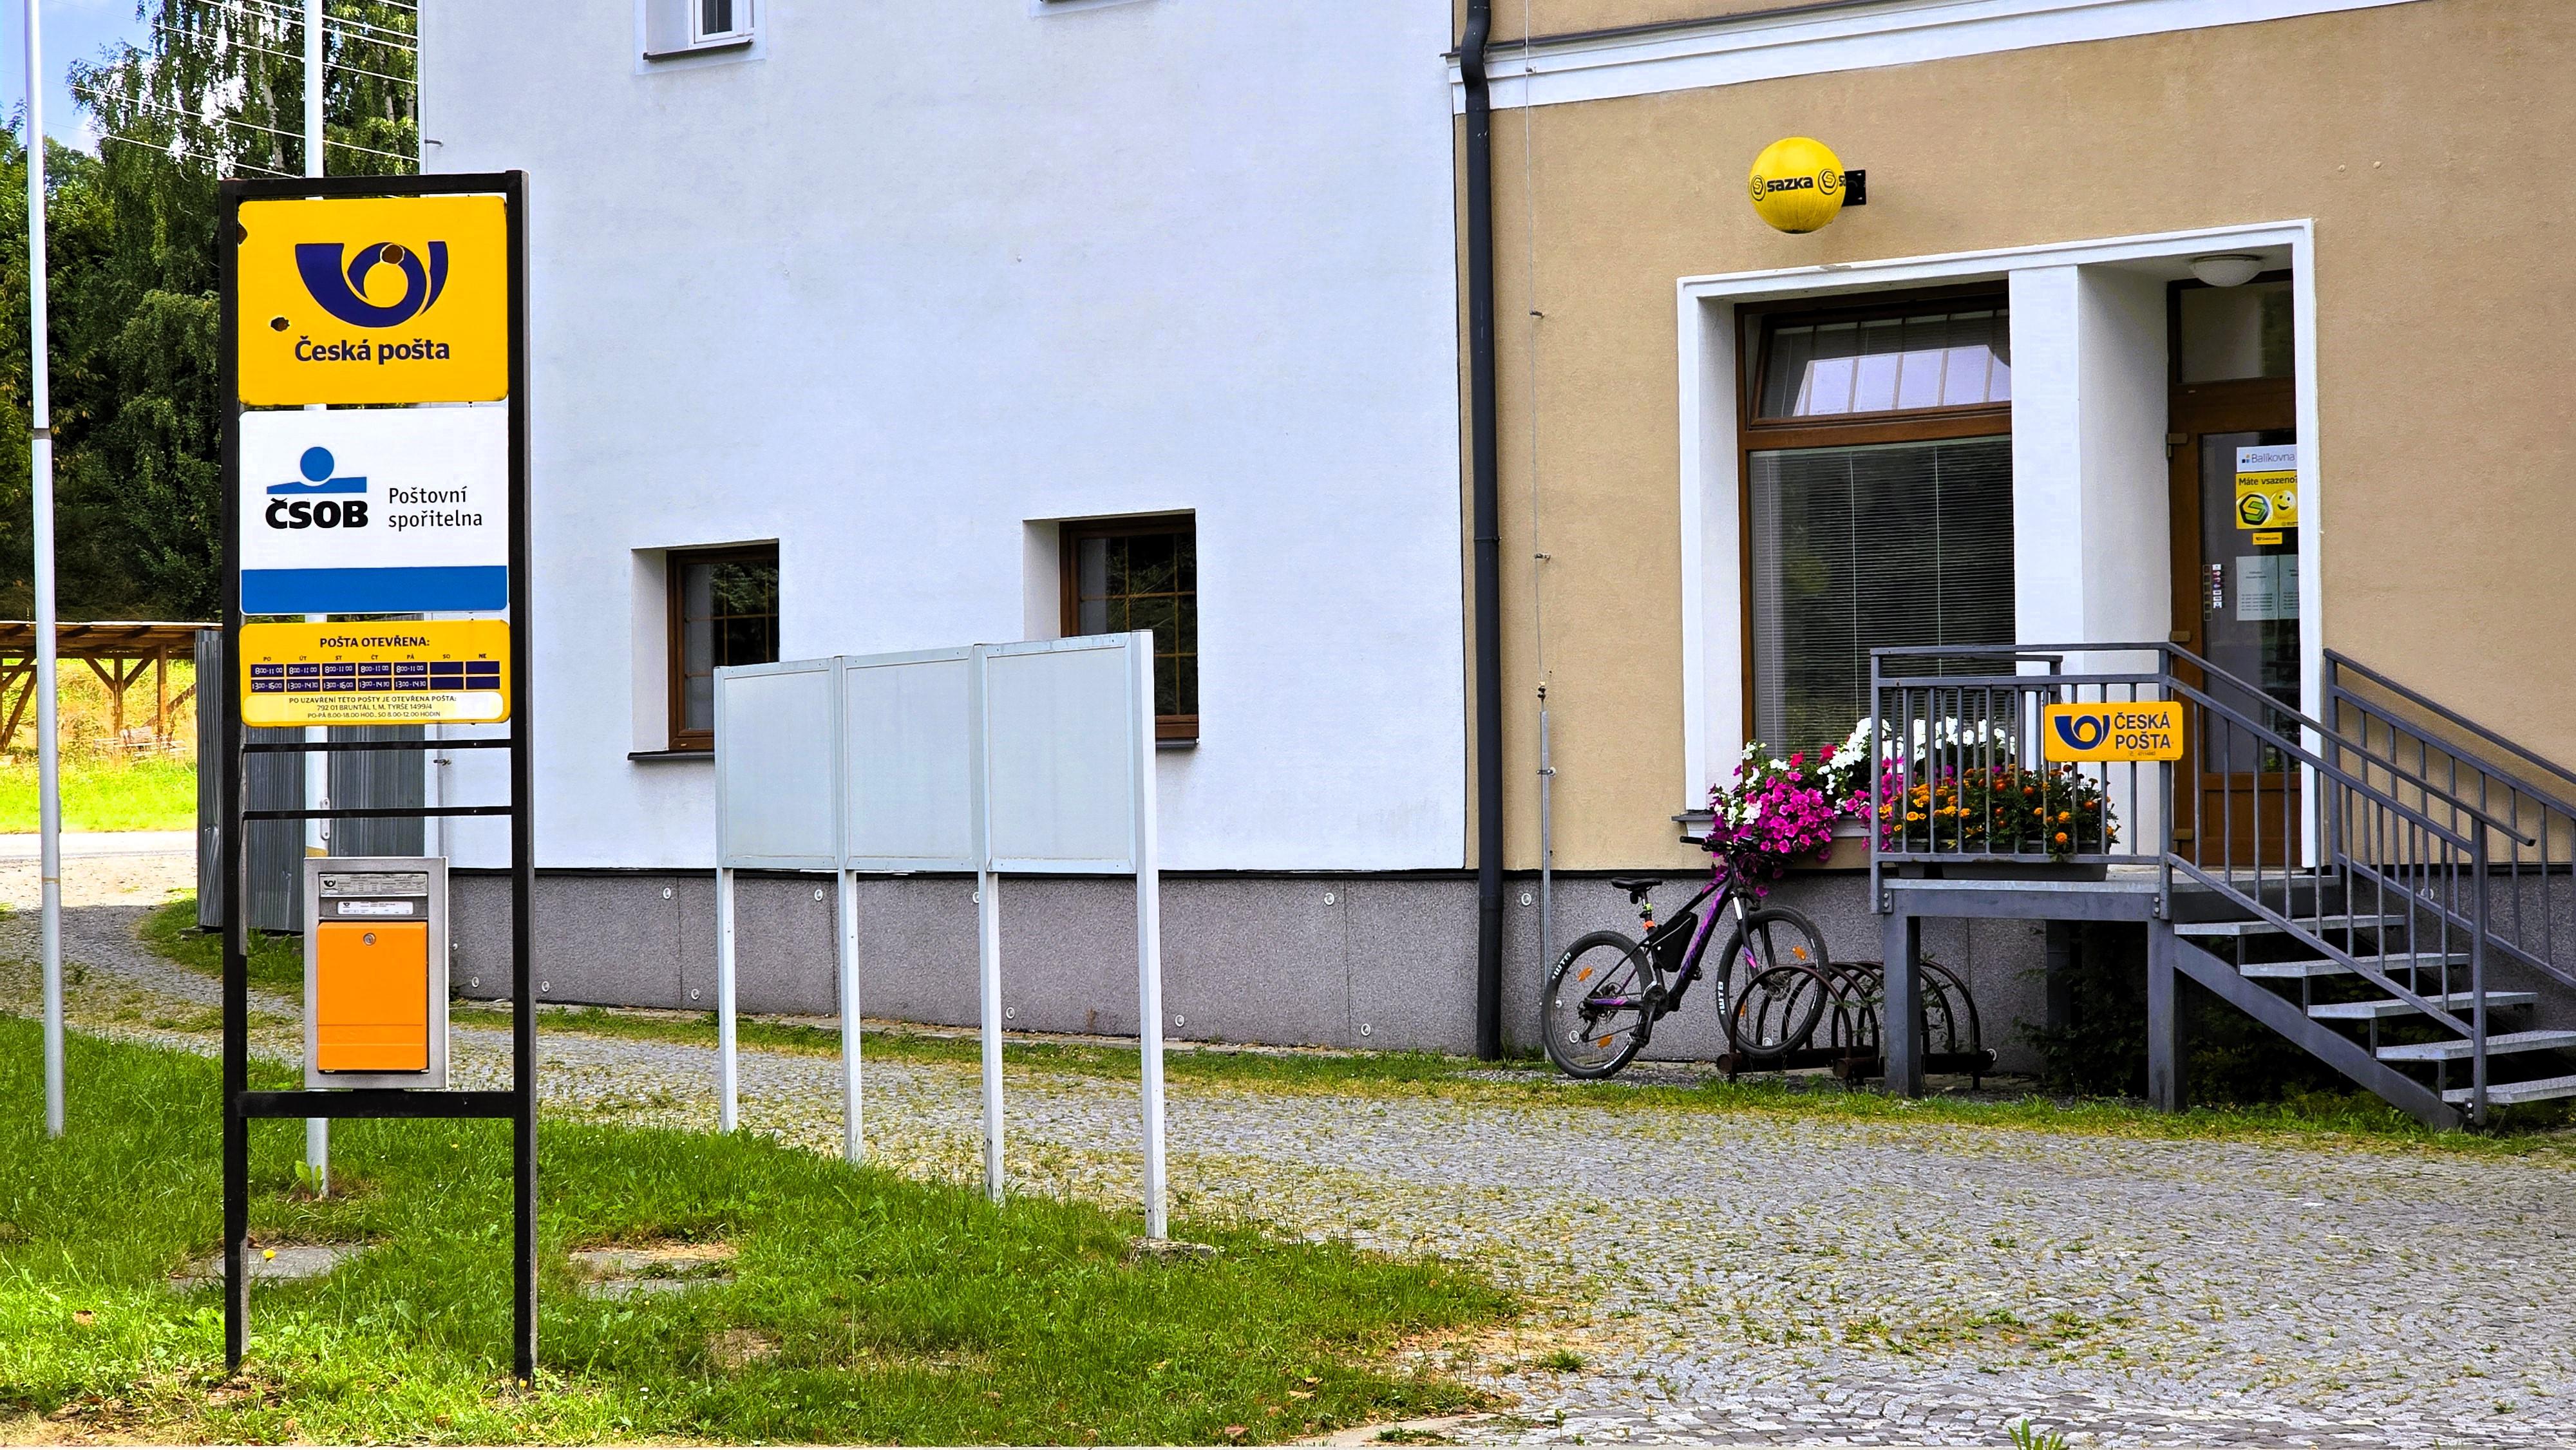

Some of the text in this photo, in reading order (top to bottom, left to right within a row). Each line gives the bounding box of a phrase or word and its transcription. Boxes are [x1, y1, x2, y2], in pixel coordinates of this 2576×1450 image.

[1766, 176, 1814, 193] sazka
[295, 336, 450, 364] Česká pošta
[2251, 453, 2296, 463] Balíkovna
[2239, 477, 2259, 485] Máte
[265, 486, 468, 529] ČSOB Poštovní
[388, 511, 482, 531] spořitelna
[320, 635, 430, 648] POŠTA OTEVŘENA:
[2114, 711, 2170, 730] ČESKÁ
[2116, 731, 2170, 749] POŠTA
